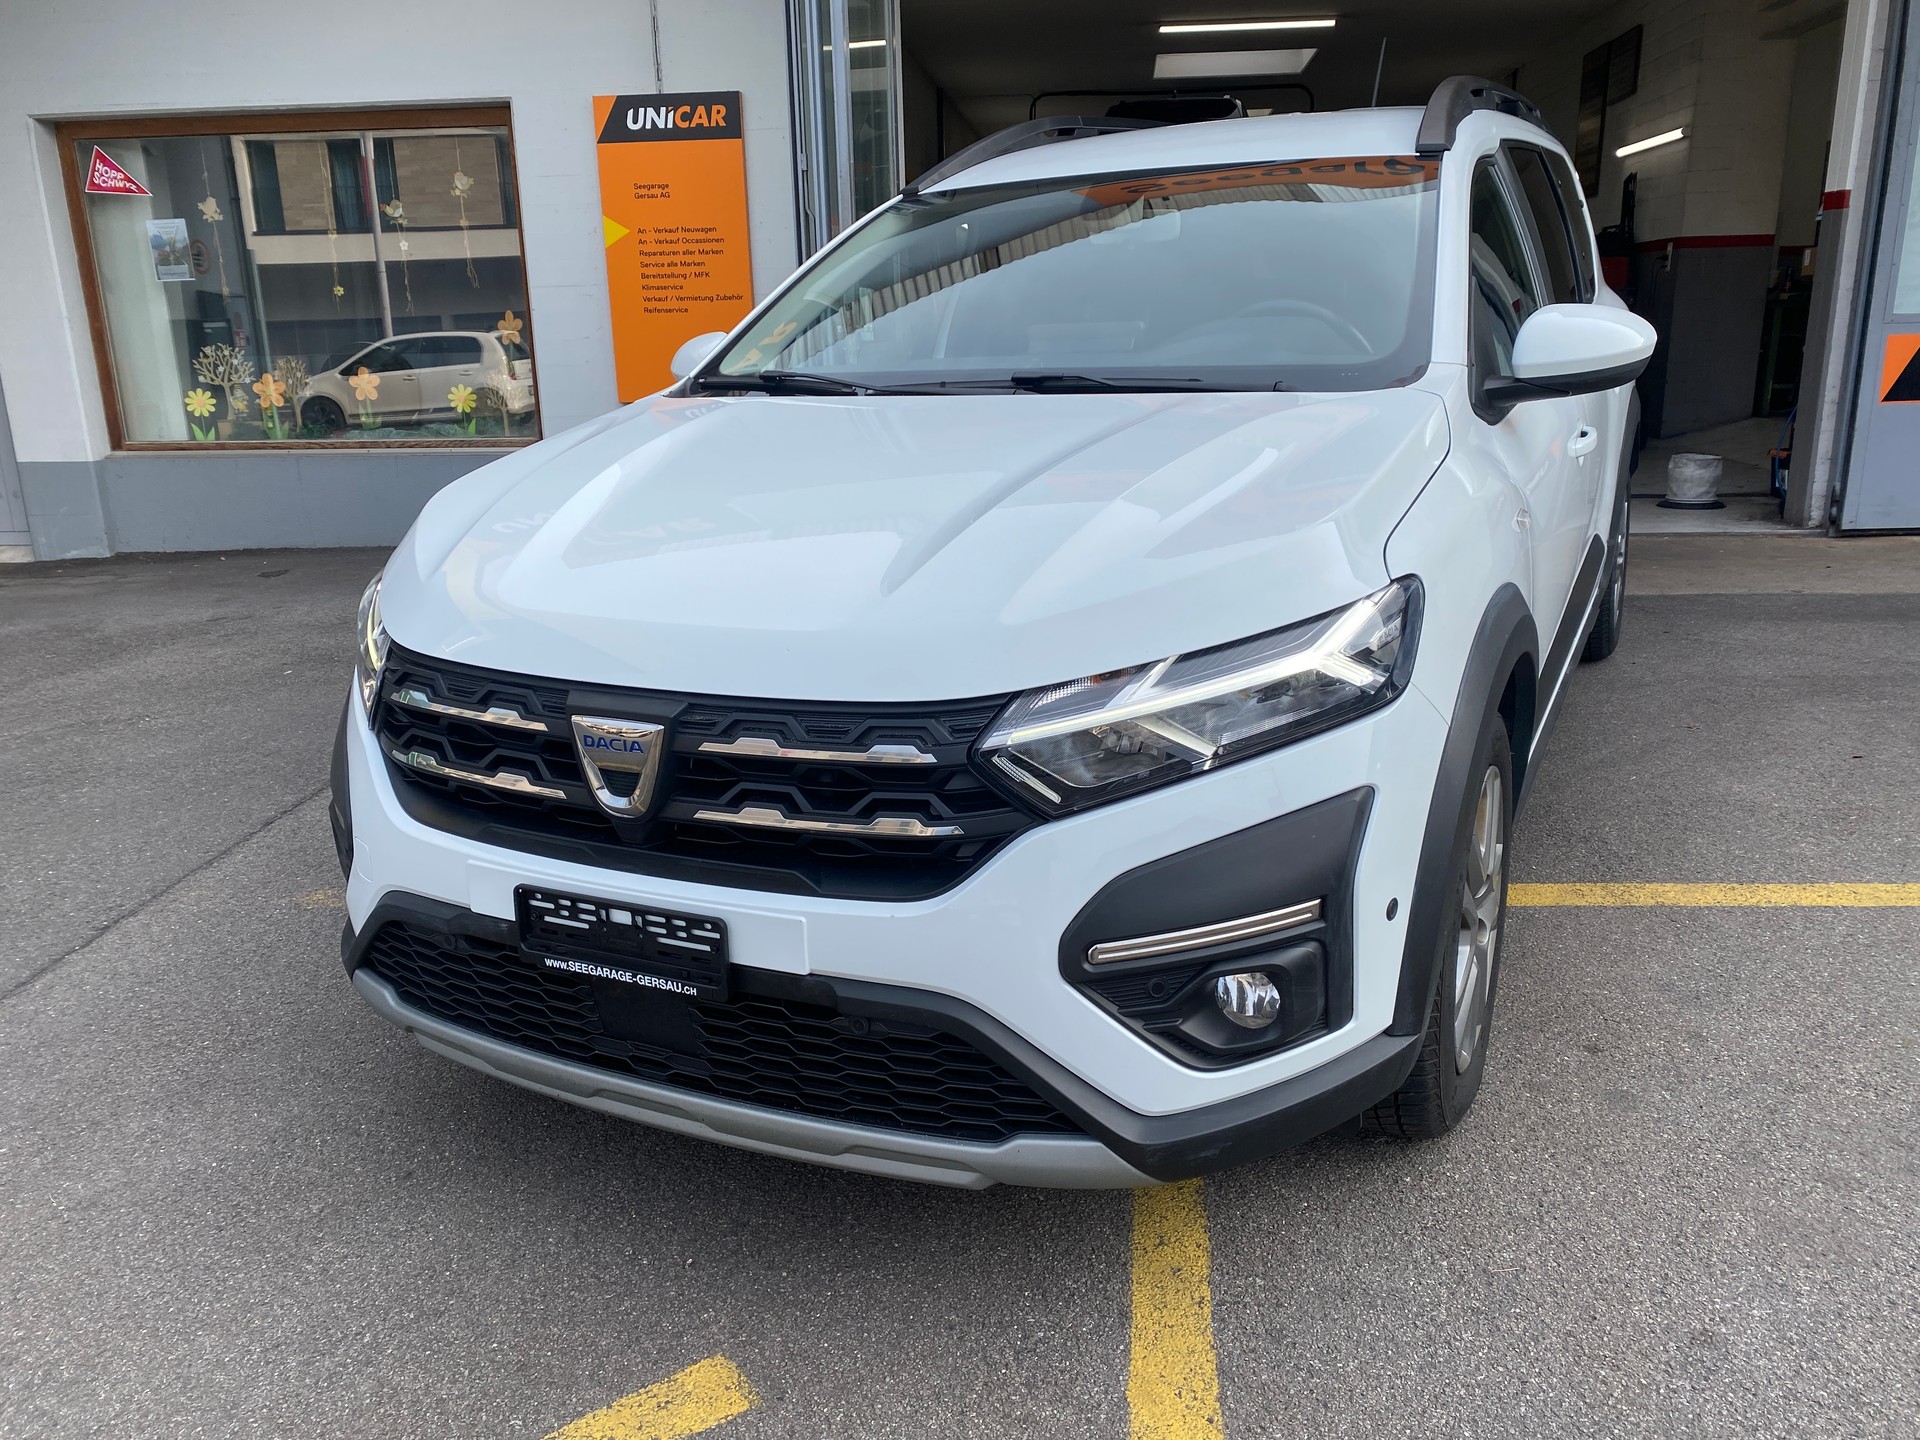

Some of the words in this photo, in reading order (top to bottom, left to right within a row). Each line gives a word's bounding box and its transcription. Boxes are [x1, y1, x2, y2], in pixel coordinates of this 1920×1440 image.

[95, 159, 124, 180] HOPP
[93, 171, 139, 192] SCHWYZ
[633, 182, 670, 191] Seegarage
[634, 192, 659, 200] Gersau
[659, 191, 671, 199] AG
[637, 227, 647, 235] An
[653, 226, 680, 234] Verkauf
[681, 226, 717, 234] Neuwagen
[654, 237, 680, 245] Verkauf
[681, 236, 725, 244] Occassionen
[639, 249, 681, 258] Reparaturen
[681, 248, 696, 256] aller
[697, 248, 724, 256] Marken
[639, 261, 666, 269] Service
[679, 260, 706, 268] Marken
[640, 271, 688, 281] Bereitstellung
[693, 271, 711, 279] MFK
[641, 283, 684, 291] Klimaservice
[642, 294, 669, 303] Verkauf
[675, 294, 714, 303] Vermietung
[715, 293, 744, 302] Zubehör
[643, 306, 689, 314] Reifenservice
[583, 734, 645, 754] DACIA
